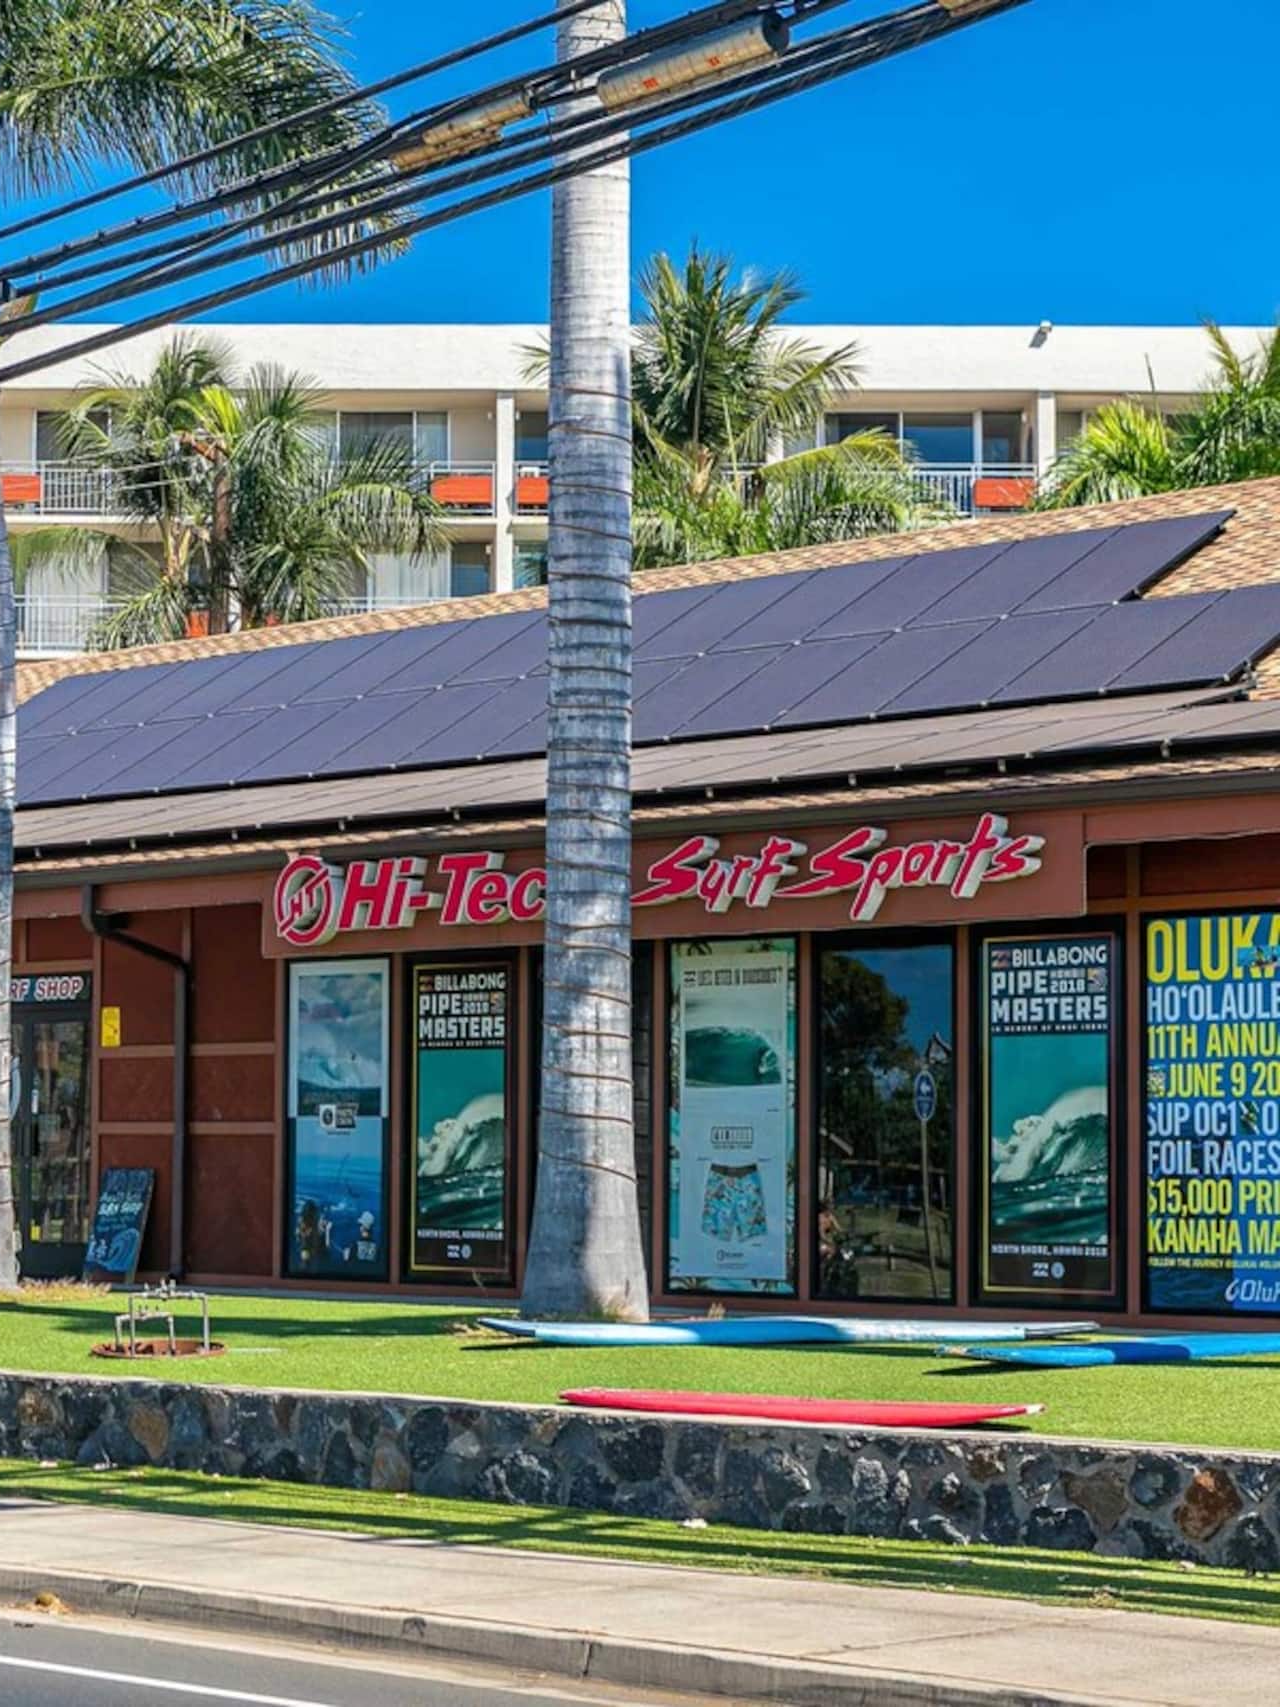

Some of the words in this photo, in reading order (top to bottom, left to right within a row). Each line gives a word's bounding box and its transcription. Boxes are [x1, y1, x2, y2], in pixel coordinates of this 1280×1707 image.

[773, 813, 1044, 921] Sports
[1012, 945, 1107, 968] BILLABONG
[34, 976, 84, 1001] SHOP
[434, 972, 506, 991] BILLABONG
[991, 969, 1047, 995] PIPE
[1050, 979, 1085, 993] 2018
[419, 992, 461, 1015] PIPE
[991, 995, 1107, 1023] MASTERS
[419, 1015, 505, 1039] MASTERS
[1148, 1023, 1198, 1059] 11TH
[1206, 1021, 1280, 1057] ANNU
[1167, 1062, 1225, 1098] JUNE
[1230, 1062, 1247, 1098] 9
[1251, 1061, 1280, 1096] 20
[1147, 1102, 1190, 1136] SUP
[1194, 1100, 1237, 1136] OC1
[1147, 1139, 1199, 1175] FOIL
[1203, 1139, 1280, 1175] RACES
[1147, 1177, 1233, 1217] $15,000
[1239, 1179, 1280, 1215] PRI
[1147, 1218, 1242, 1254] KANAHA
[1248, 1219, 1280, 1254] MA
